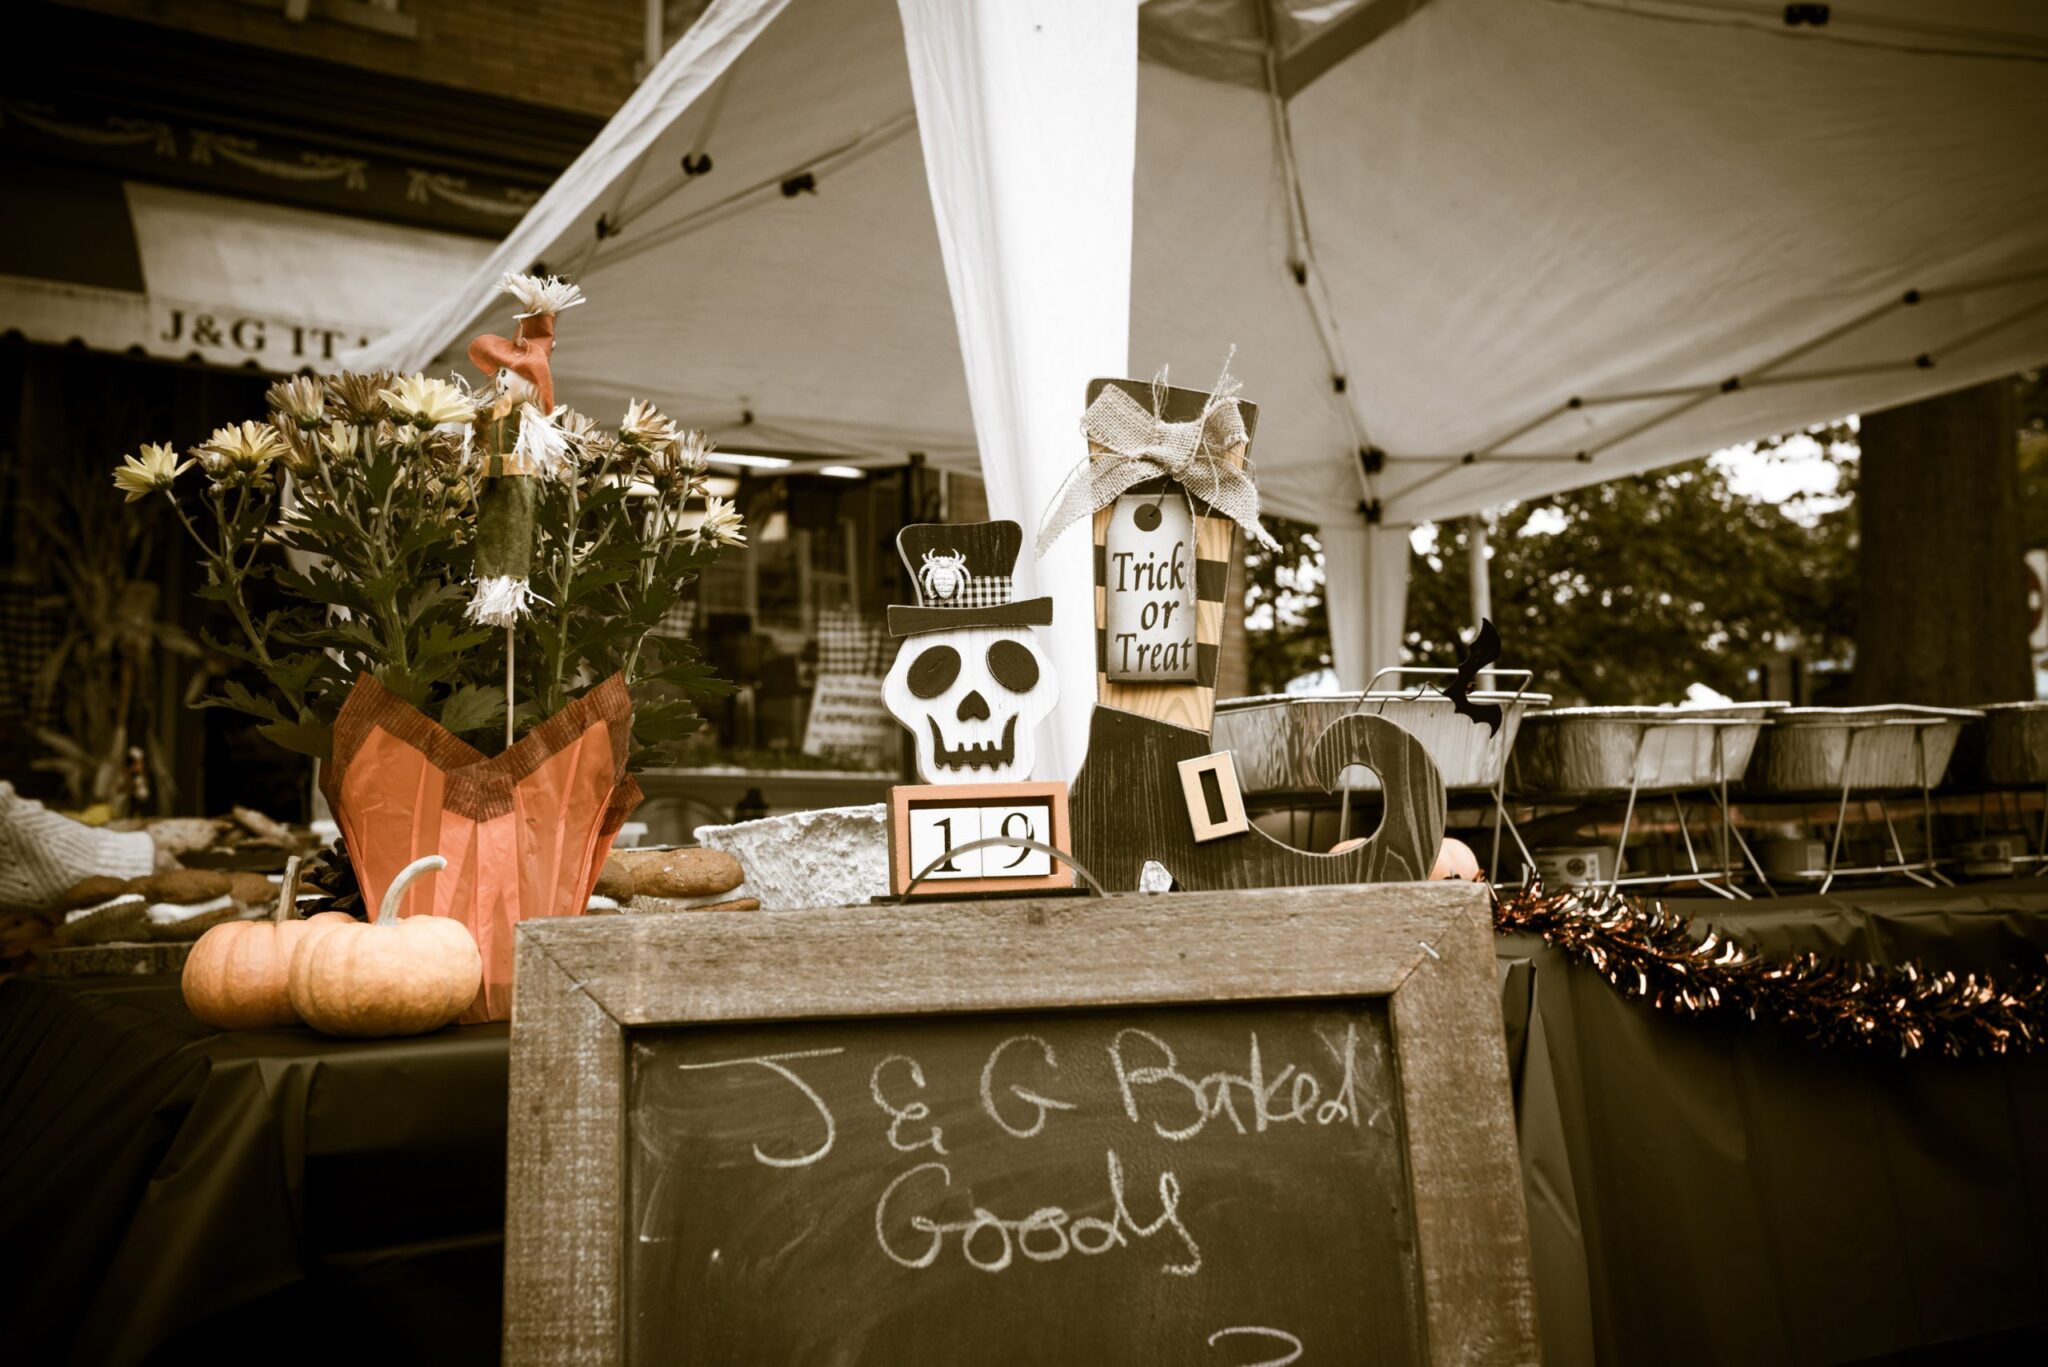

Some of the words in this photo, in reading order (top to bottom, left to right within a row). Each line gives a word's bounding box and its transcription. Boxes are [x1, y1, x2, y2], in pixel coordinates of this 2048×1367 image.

[160, 309, 266, 352] J&G
[291, 325, 369, 359] IT
[1112, 541, 1186, 592] Trick
[1141, 600, 1180, 631] or
[1115, 633, 1193, 673] Treat
[932, 812, 1035, 873] 19
[678, 1046, 845, 1167] J
[979, 1034, 1077, 1138] G
